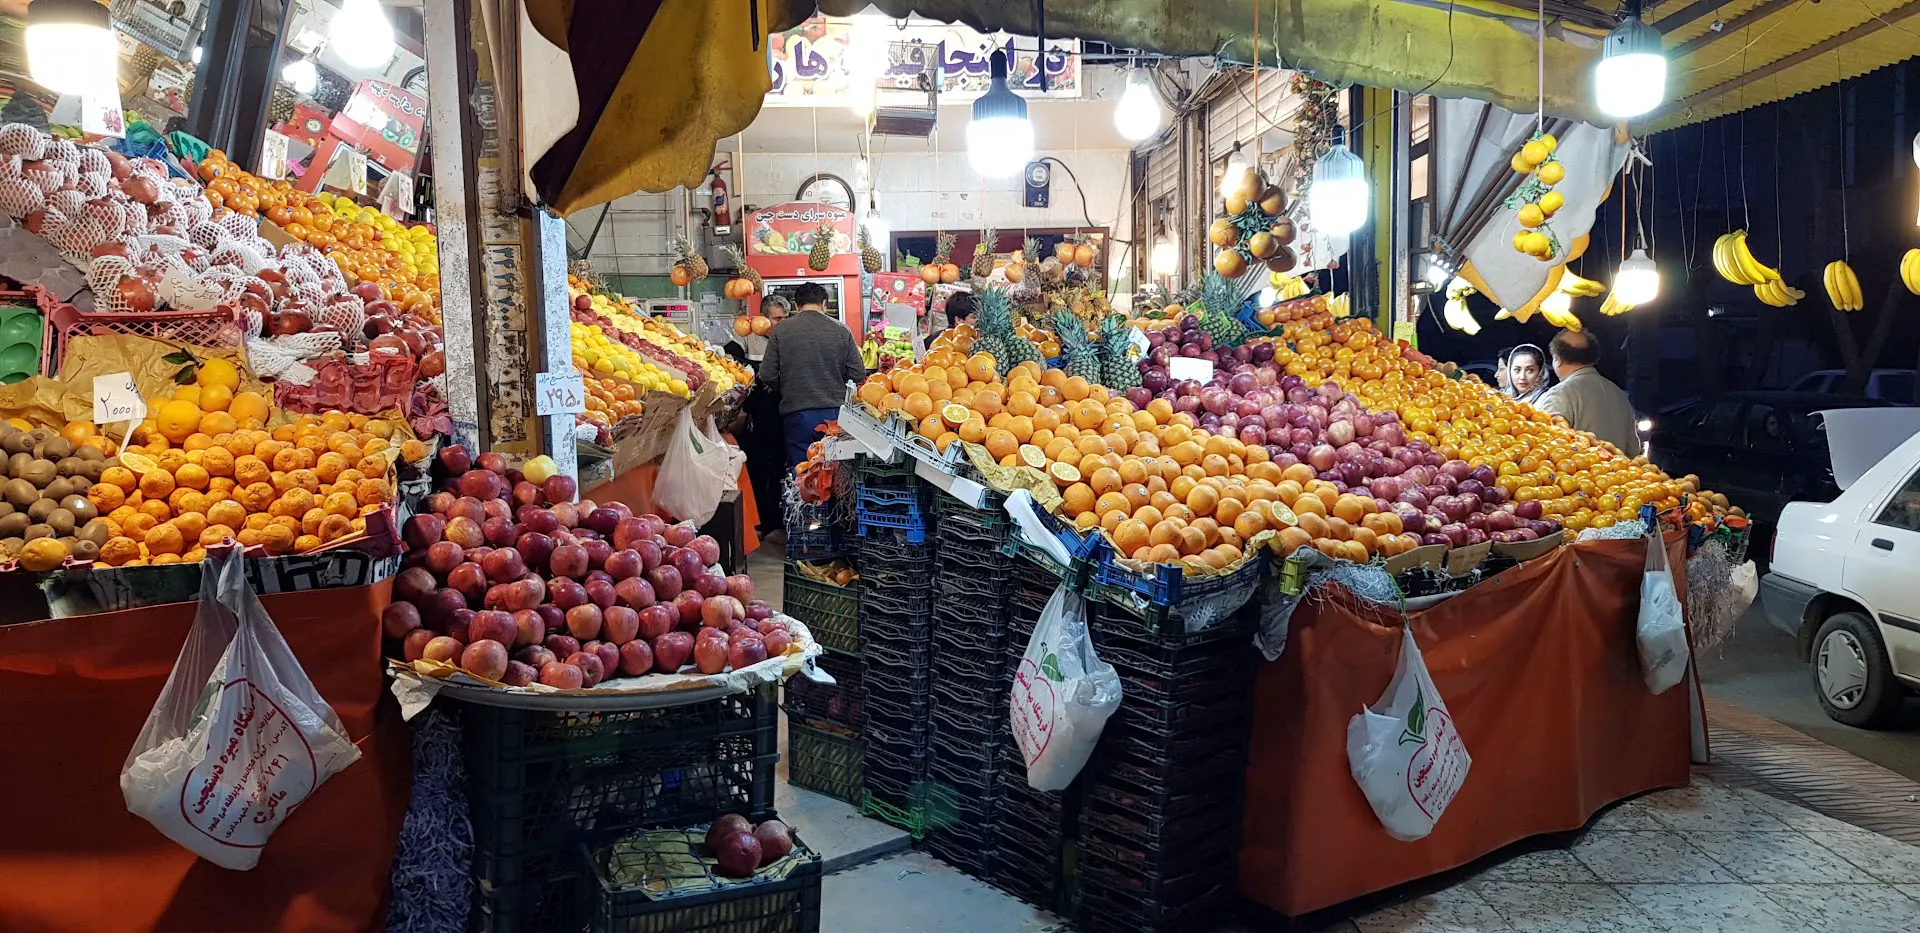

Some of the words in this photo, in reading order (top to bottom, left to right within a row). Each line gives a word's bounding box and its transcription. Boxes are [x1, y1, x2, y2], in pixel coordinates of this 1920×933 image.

[794, 40, 829, 77] ها
[938, 36, 1016, 85] انجا
[1024, 46, 1068, 88] در
[756, 210, 775, 222] چین
[777, 210, 799, 219] دست
[801, 208, 825, 221] سرای
[827, 211, 846, 221] میوه
[566, 373, 583, 382] سیب
[219, 738, 240, 764] میوه
[1413, 758, 1434, 788] دستچین
[192, 764, 225, 814] دستچین
